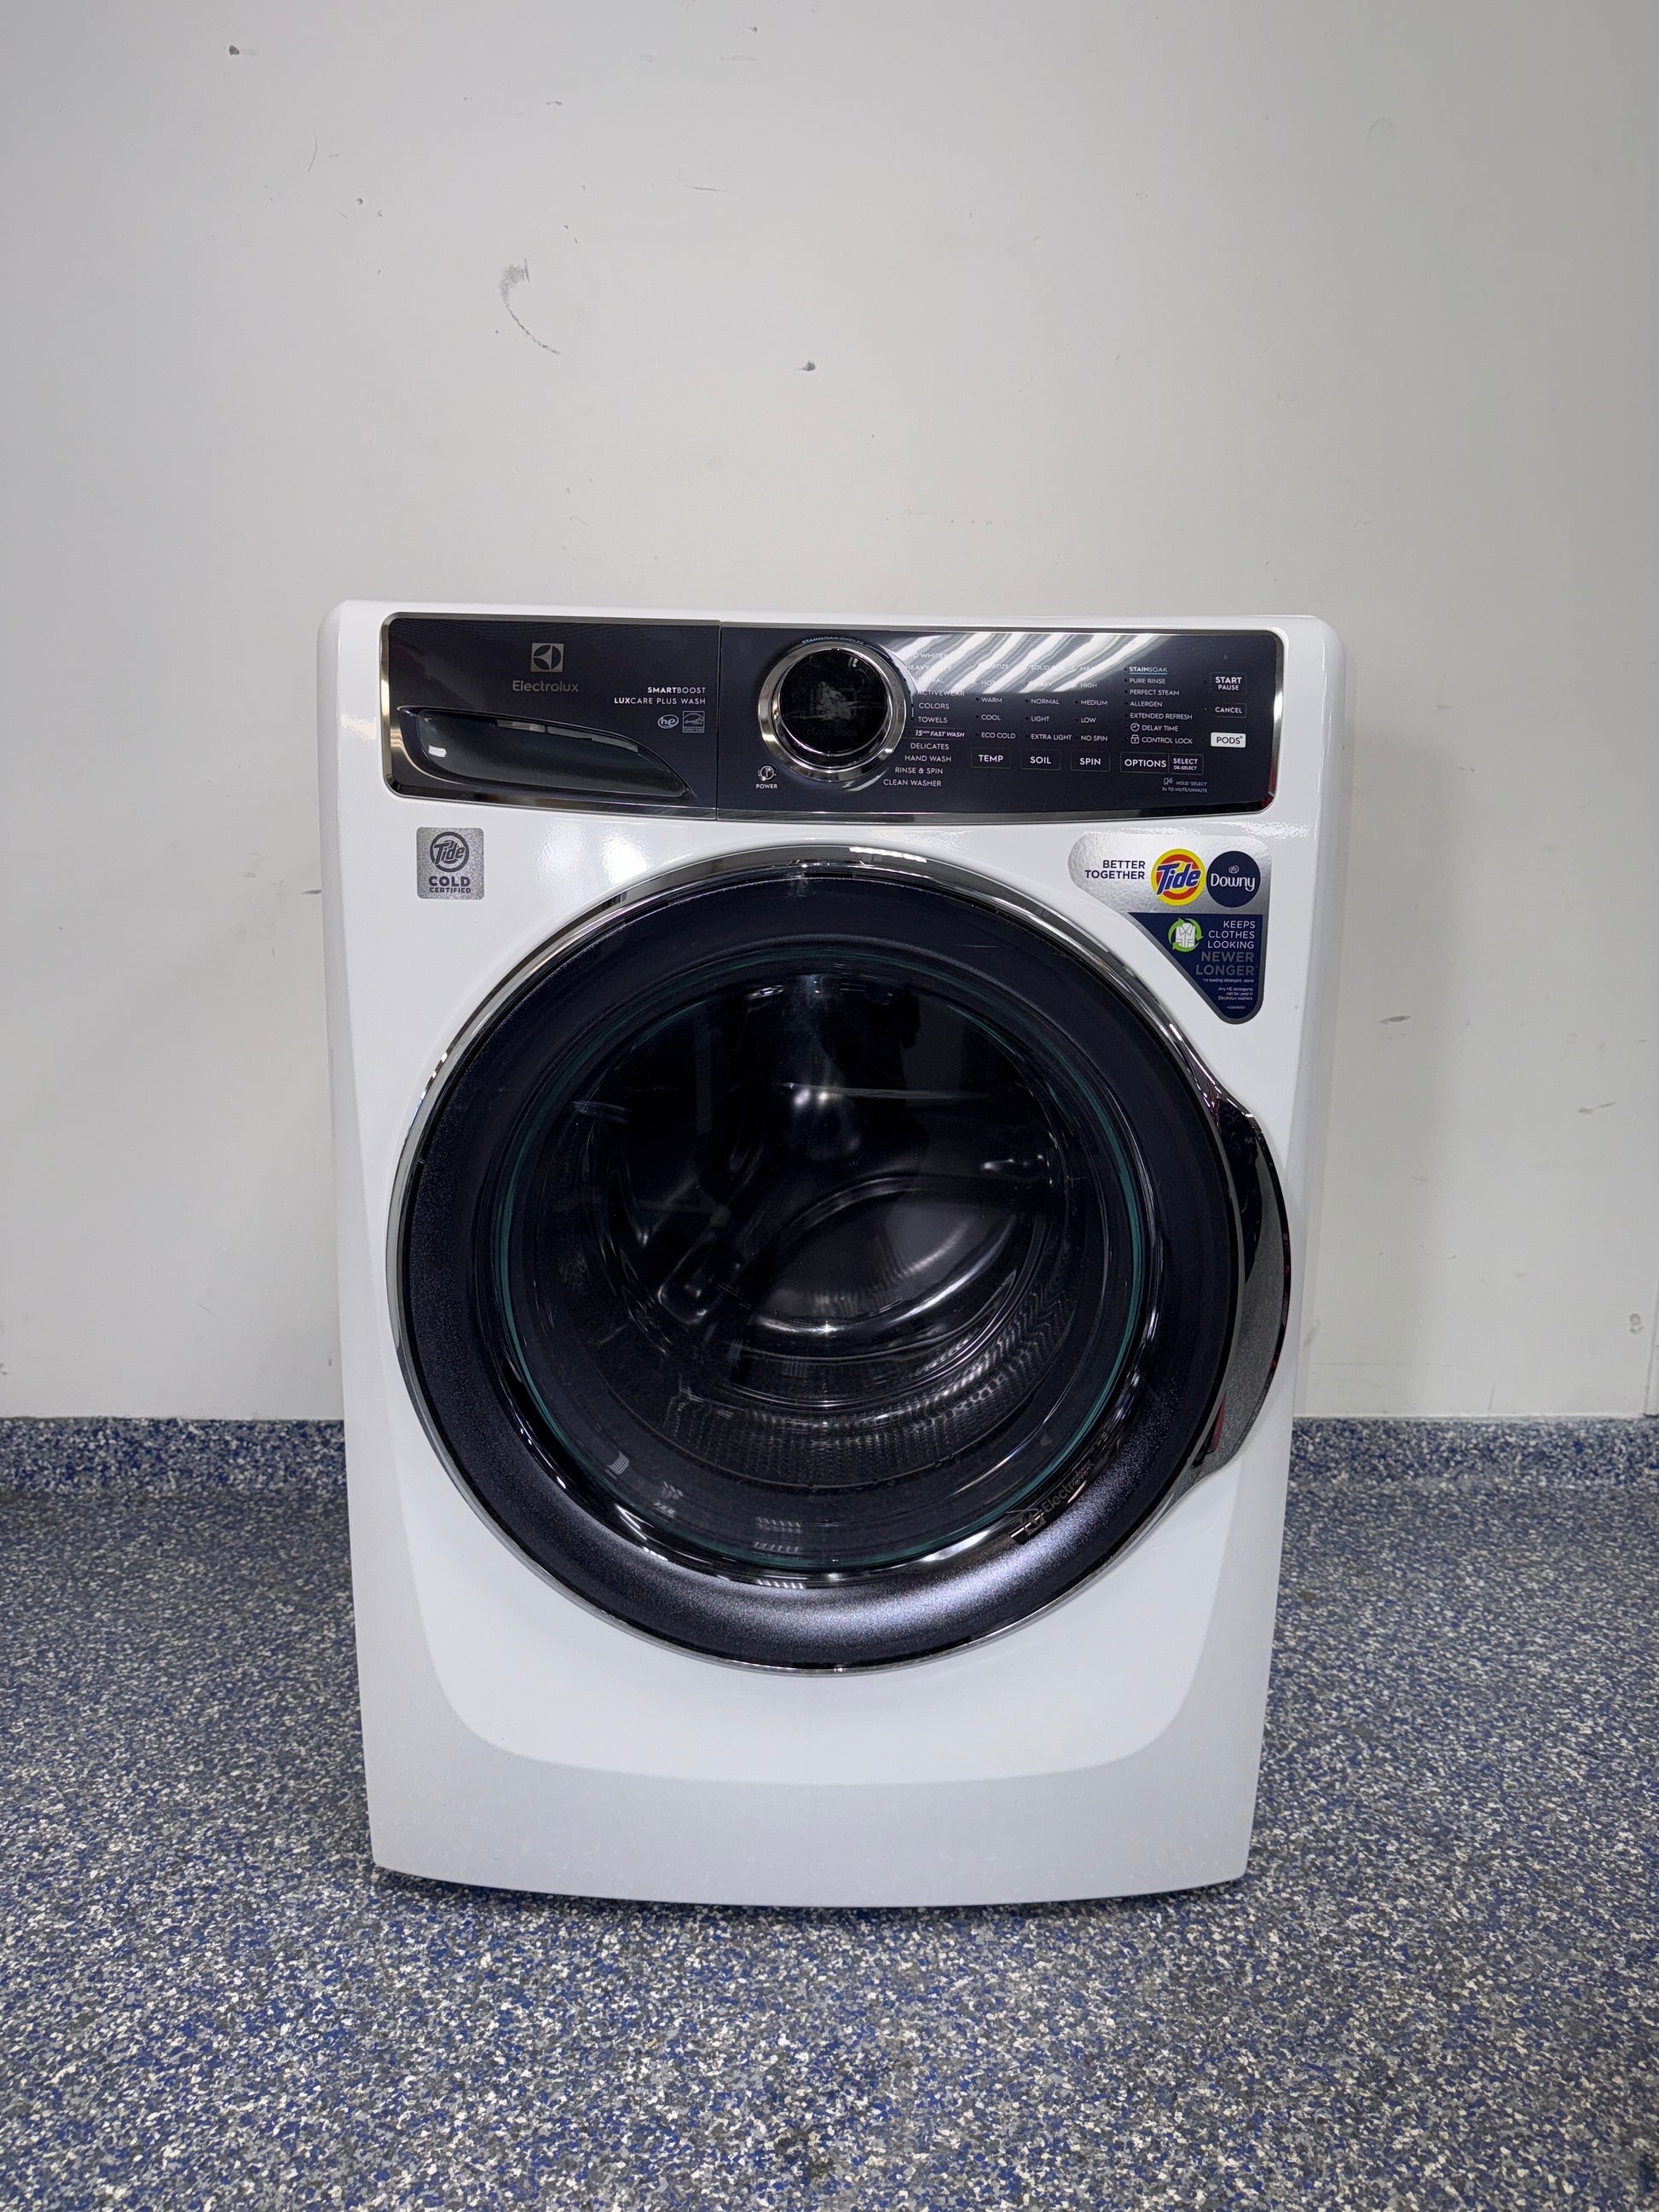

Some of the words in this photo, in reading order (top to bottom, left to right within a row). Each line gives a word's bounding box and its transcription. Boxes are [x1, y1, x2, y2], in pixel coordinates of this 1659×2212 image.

[1215, 676, 1242, 684] START
[512, 679, 579, 692] Electrolux
[661, 717, 676, 725] he
[1030, 756, 1052, 765] SOIL
[1079, 757, 1101, 765] SPIN
[1124, 759, 1167, 768] OPTIONS
[433, 840, 465, 865] Tide
[1102, 859, 1146, 869] BETTER
[1084, 869, 1145, 880] TOGETHER
[1155, 861, 1201, 895] Tide
[428, 875, 471, 887] COLD
[1210, 873, 1256, 892] Downy
[1223, 920, 1256, 929] KEEPS
[1208, 930, 1255, 939] CLOTHES
[1207, 940, 1255, 949] LOOKING
[1200, 950, 1255, 963] NEWER
